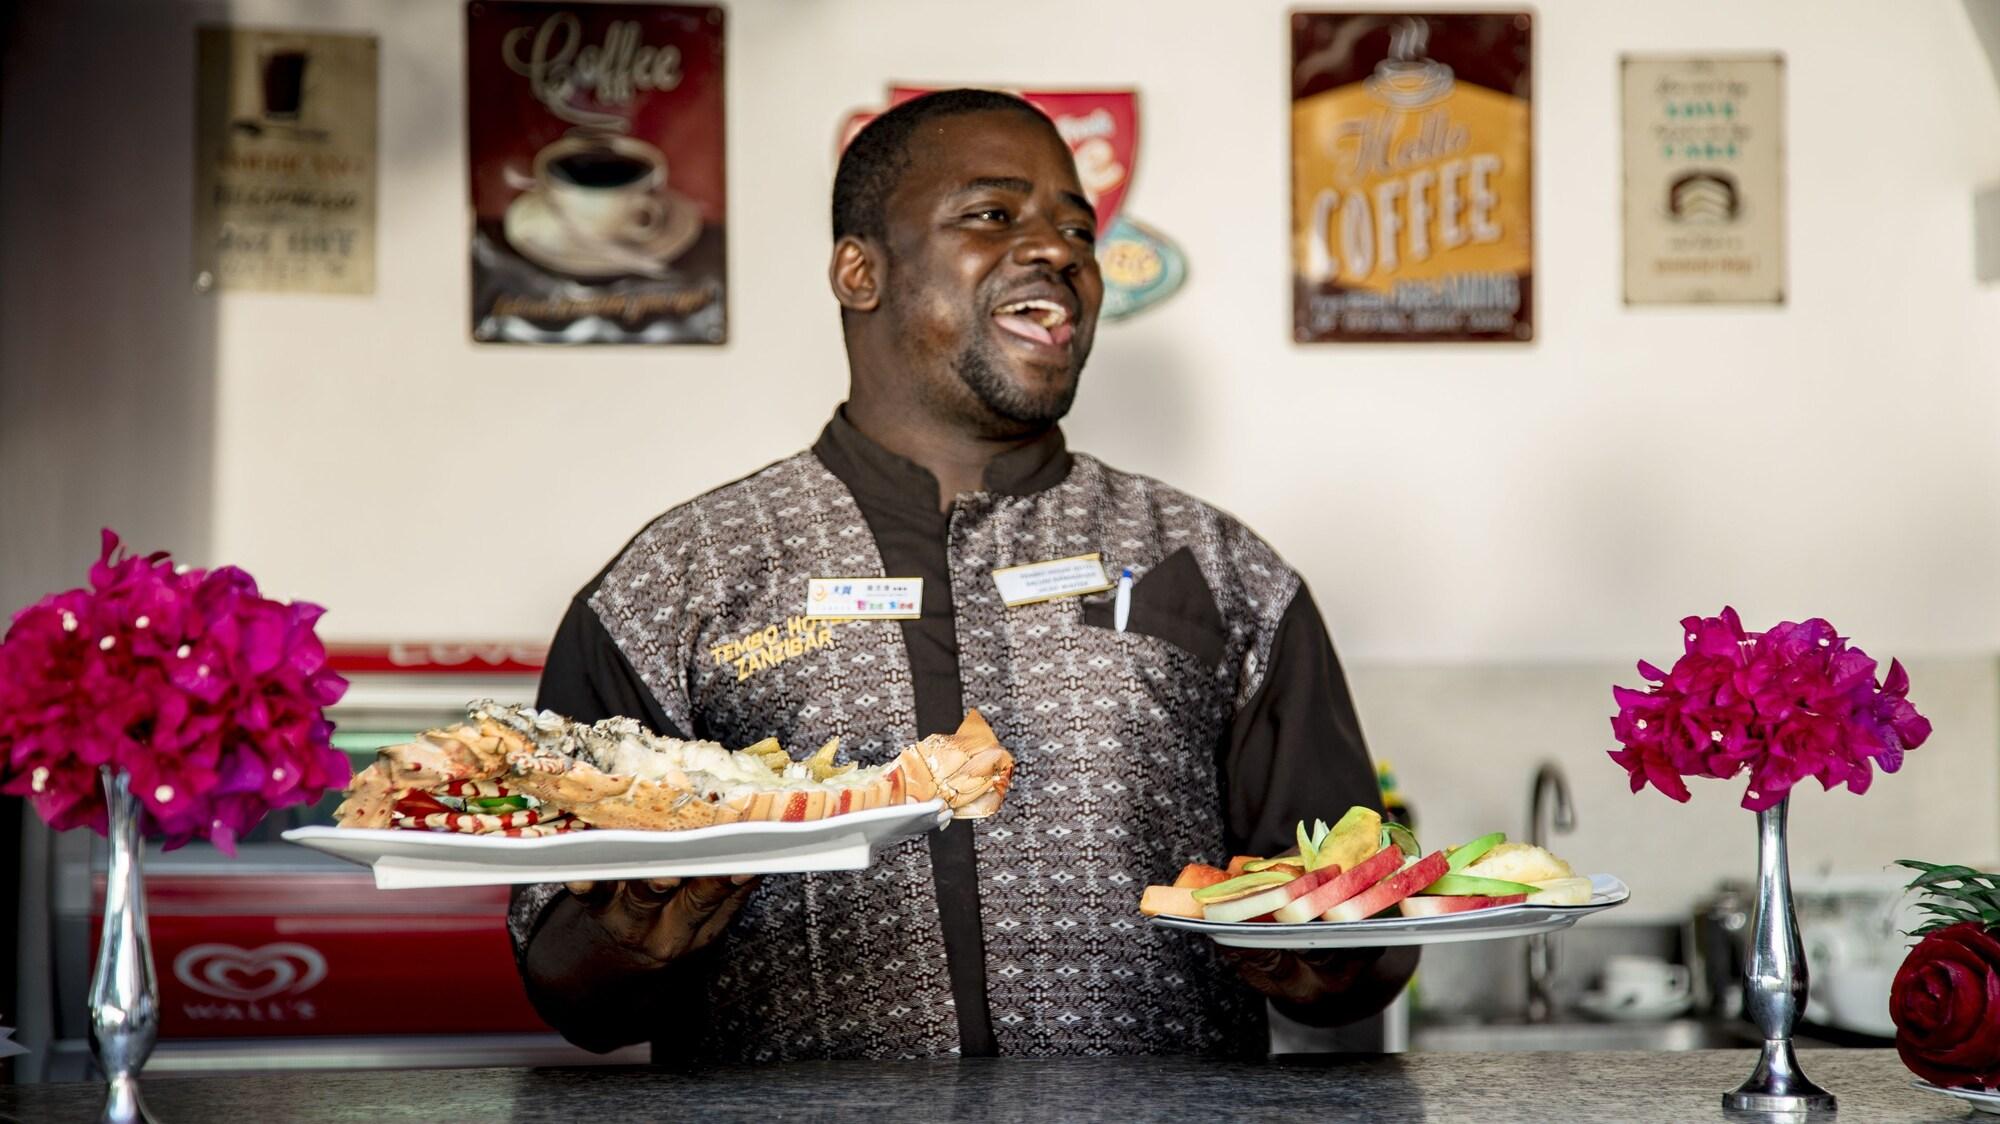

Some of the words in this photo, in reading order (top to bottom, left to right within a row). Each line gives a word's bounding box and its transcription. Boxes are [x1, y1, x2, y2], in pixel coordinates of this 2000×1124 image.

[502, 11, 682, 114] Coffee
[1333, 106, 1473, 180] Hello
[1309, 152, 1502, 283] COFFEE
[711, 624, 778, 665] TEMBO
[734, 628, 835, 681] ZANZIBAR
